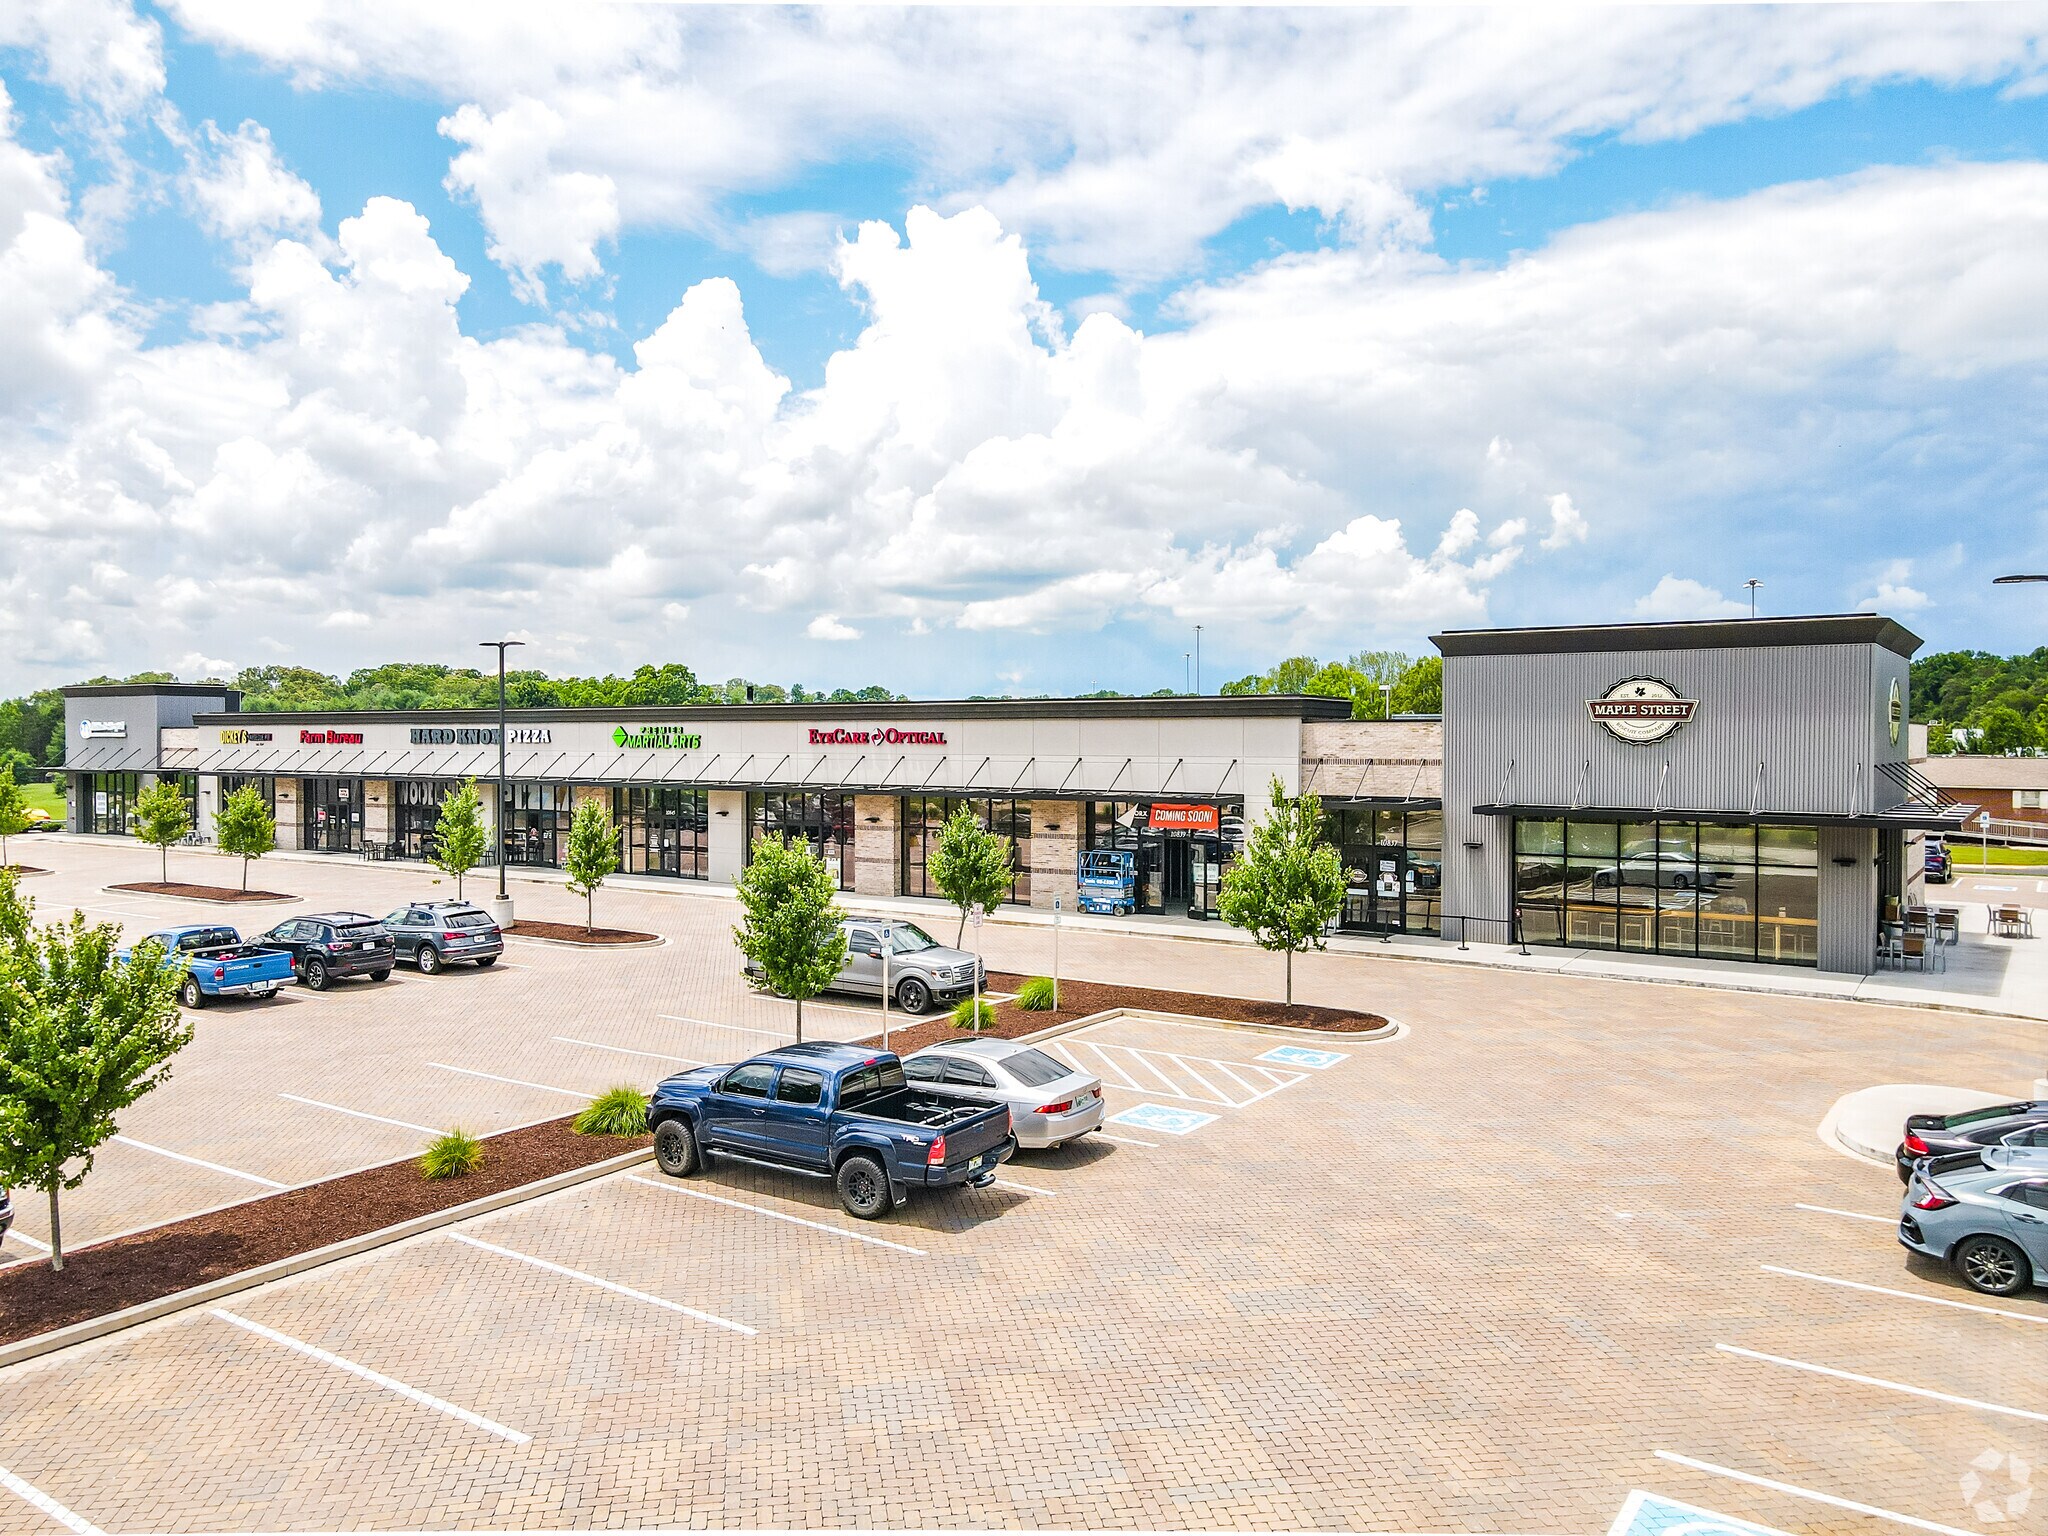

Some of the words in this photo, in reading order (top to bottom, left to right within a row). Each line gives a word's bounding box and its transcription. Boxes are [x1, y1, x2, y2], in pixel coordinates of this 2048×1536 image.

[1594, 704, 1638, 715] MAPLE
[1640, 704, 1689, 715] STREET
[640, 726, 683, 734] PREMIER
[1616, 722, 1637, 735] BISCUIT
[1638, 722, 1665, 735] COMPANY
[300, 730, 325, 744] Farm
[326, 730, 364, 744] Bureau
[410, 729, 455, 744] HARD
[456, 729, 501, 744] KNOX
[507, 729, 551, 744] PIZZA
[626, 735, 672, 749] MARTIAL
[672, 735, 702, 749] ARTS
[1154, 809, 1186, 822] COMING
[1187, 810, 1213, 823] SOON!
